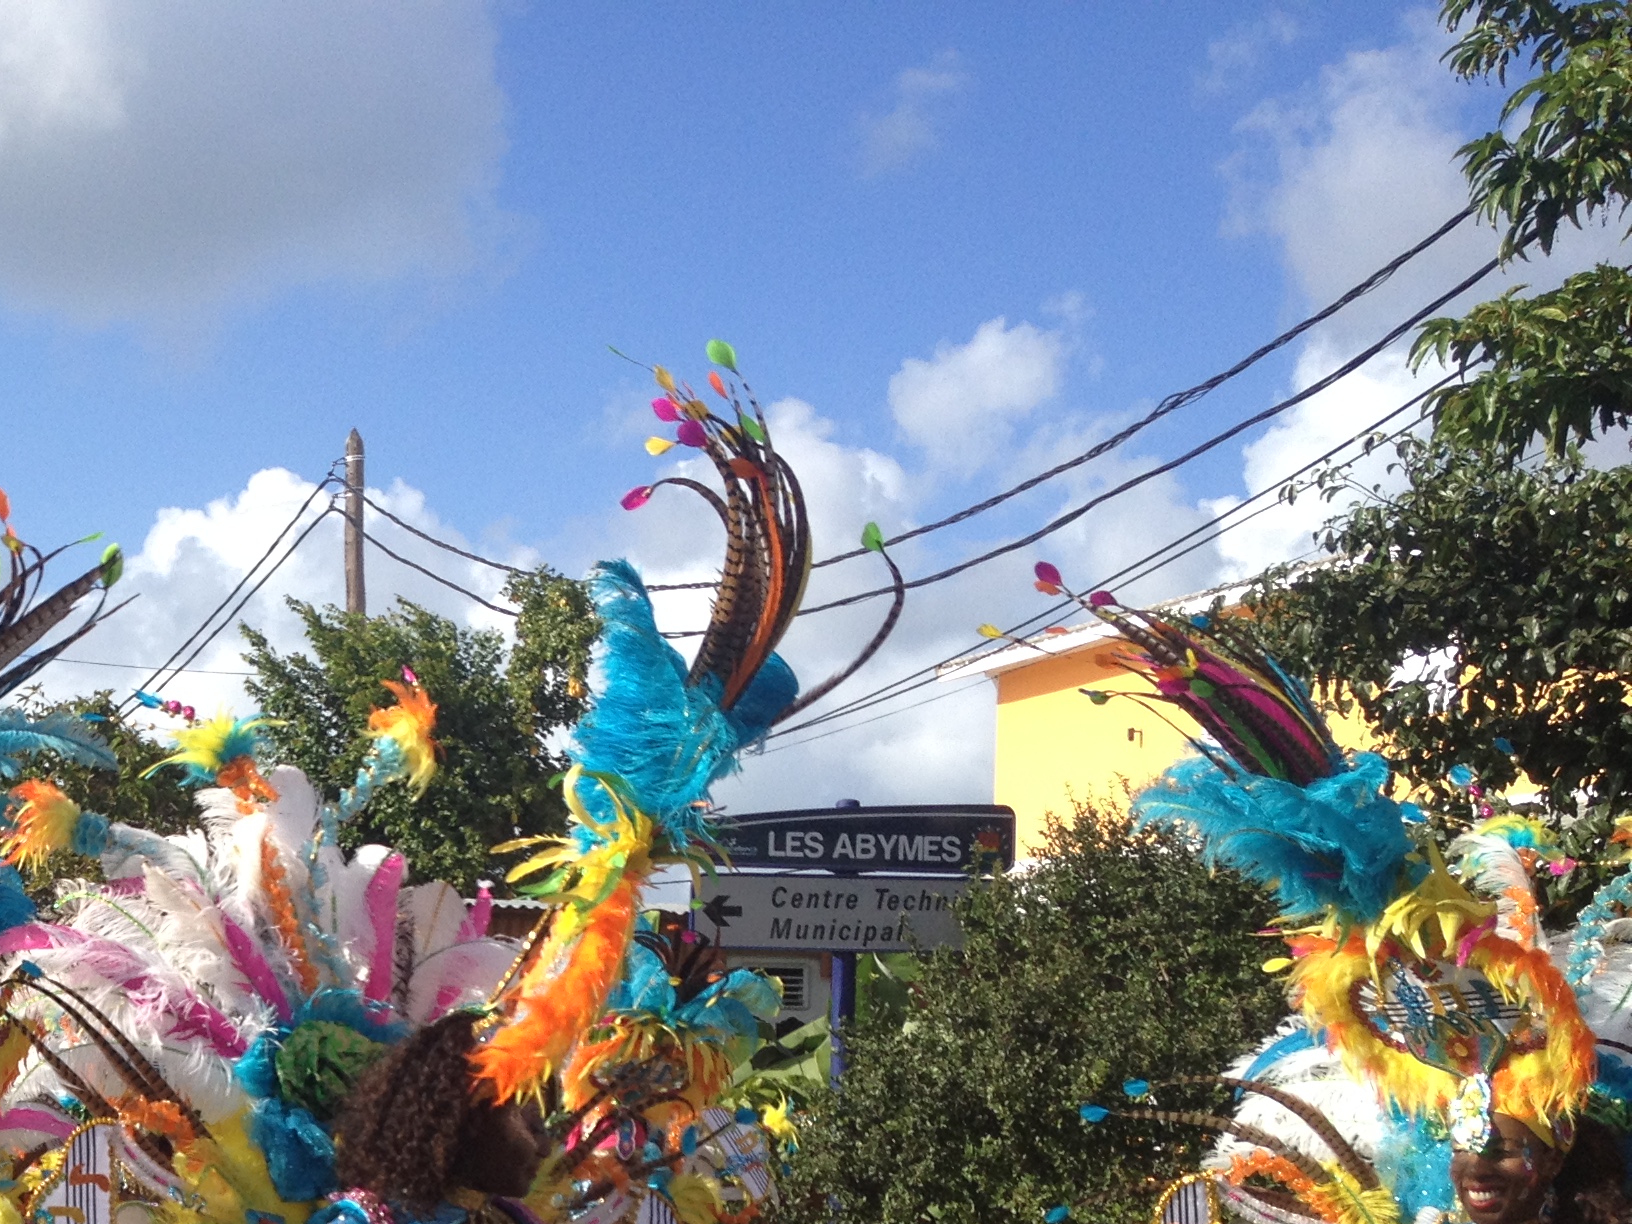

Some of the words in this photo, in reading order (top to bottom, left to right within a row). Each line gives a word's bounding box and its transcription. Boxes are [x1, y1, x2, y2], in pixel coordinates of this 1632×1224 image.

[768, 830, 825, 858] LES
[832, 833, 962, 863] ABYMES
[771, 886, 858, 911] Centre
[770, 915, 905, 947] Municipal
